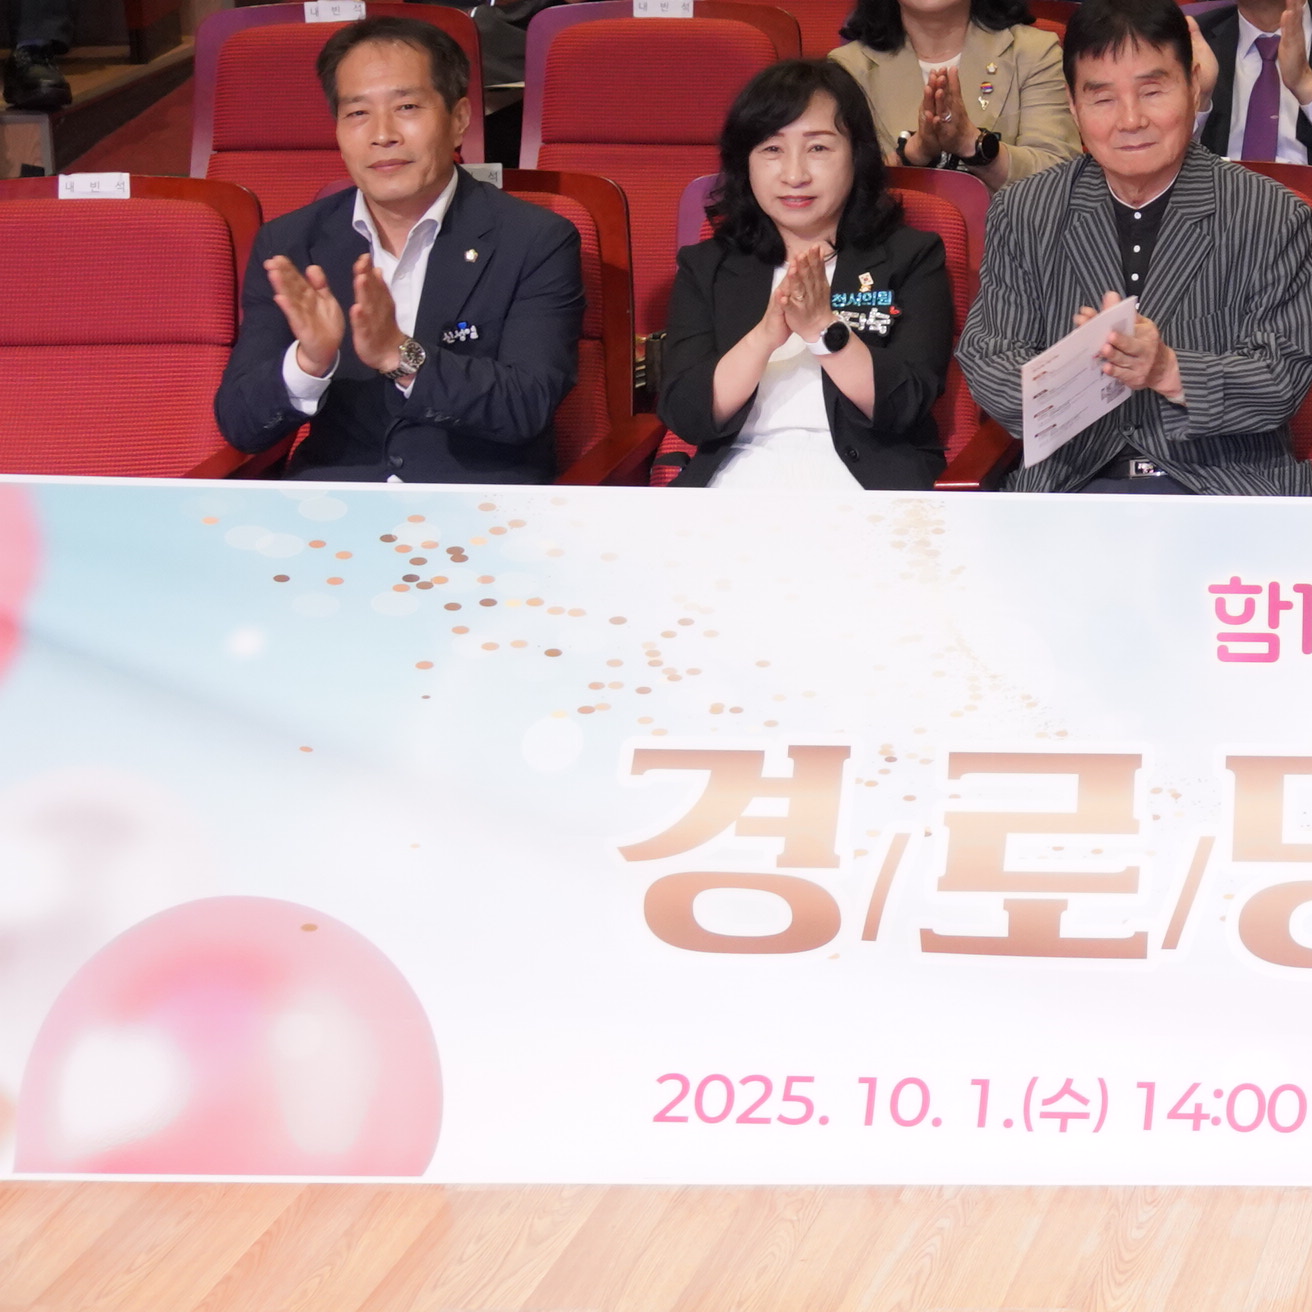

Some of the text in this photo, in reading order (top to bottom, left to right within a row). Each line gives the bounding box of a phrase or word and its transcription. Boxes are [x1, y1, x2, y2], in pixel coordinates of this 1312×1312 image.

[652, 1072, 830, 1127] 2025.
[856, 1075, 943, 1128] 10.
[1136, 1080, 1308, 1134] 14:00
